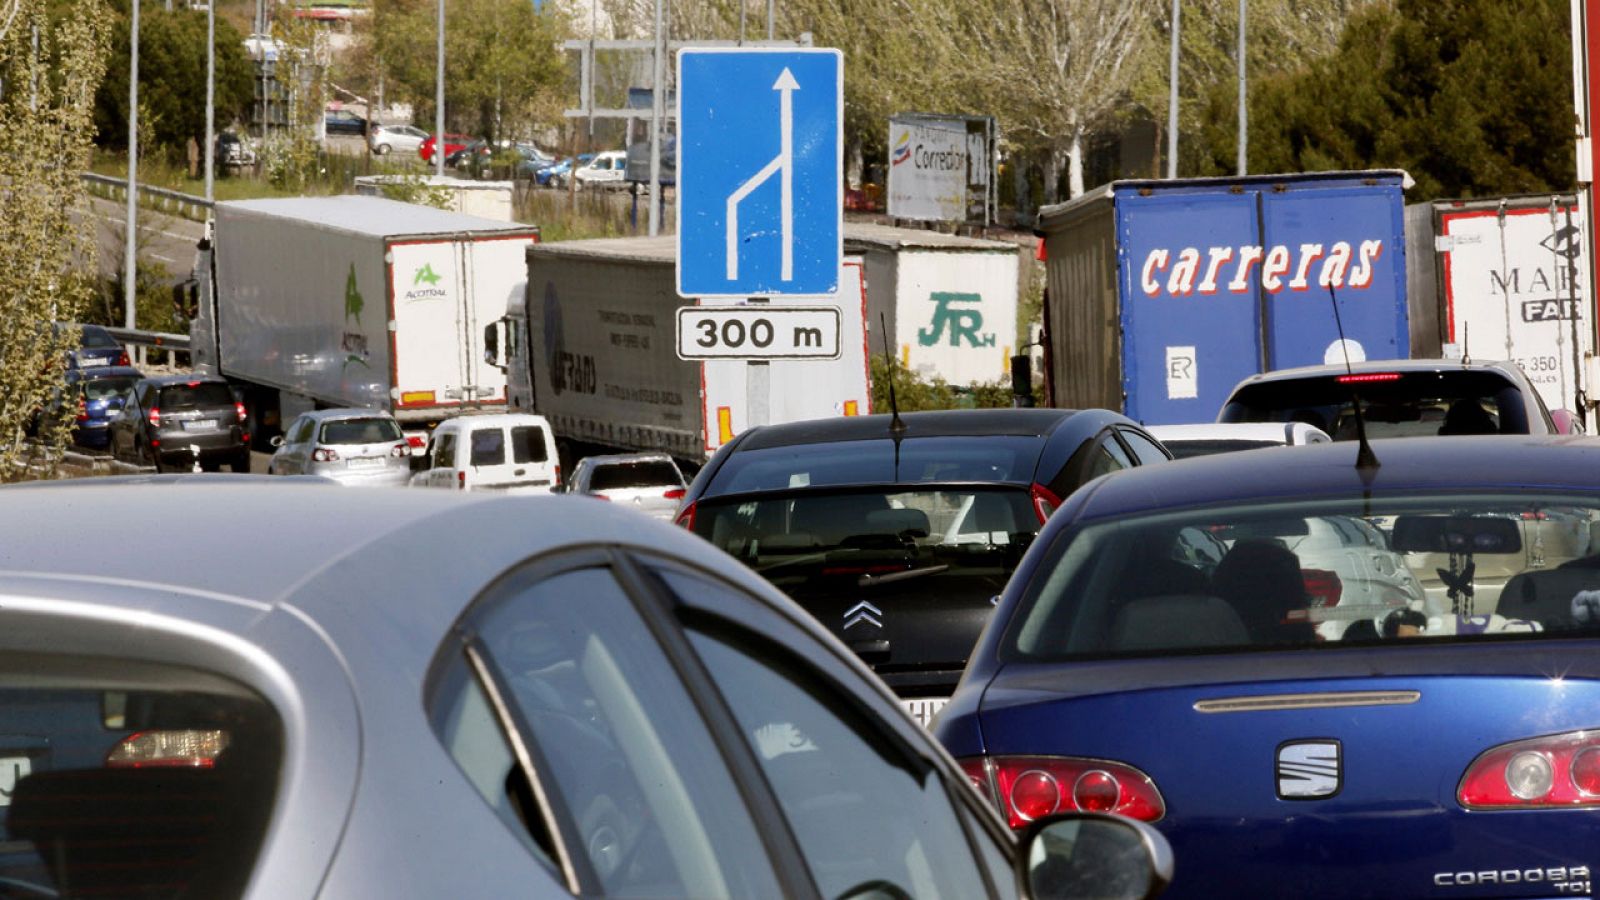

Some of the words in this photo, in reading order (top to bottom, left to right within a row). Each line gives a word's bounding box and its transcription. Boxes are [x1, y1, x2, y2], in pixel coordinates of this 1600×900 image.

[1141, 239, 1382, 297] carreras
[696, 318, 774, 348] 300
[793, 326, 822, 347] m
[1530, 356, 1557, 371] 350
[1433, 866, 1590, 886] CORDOBA
